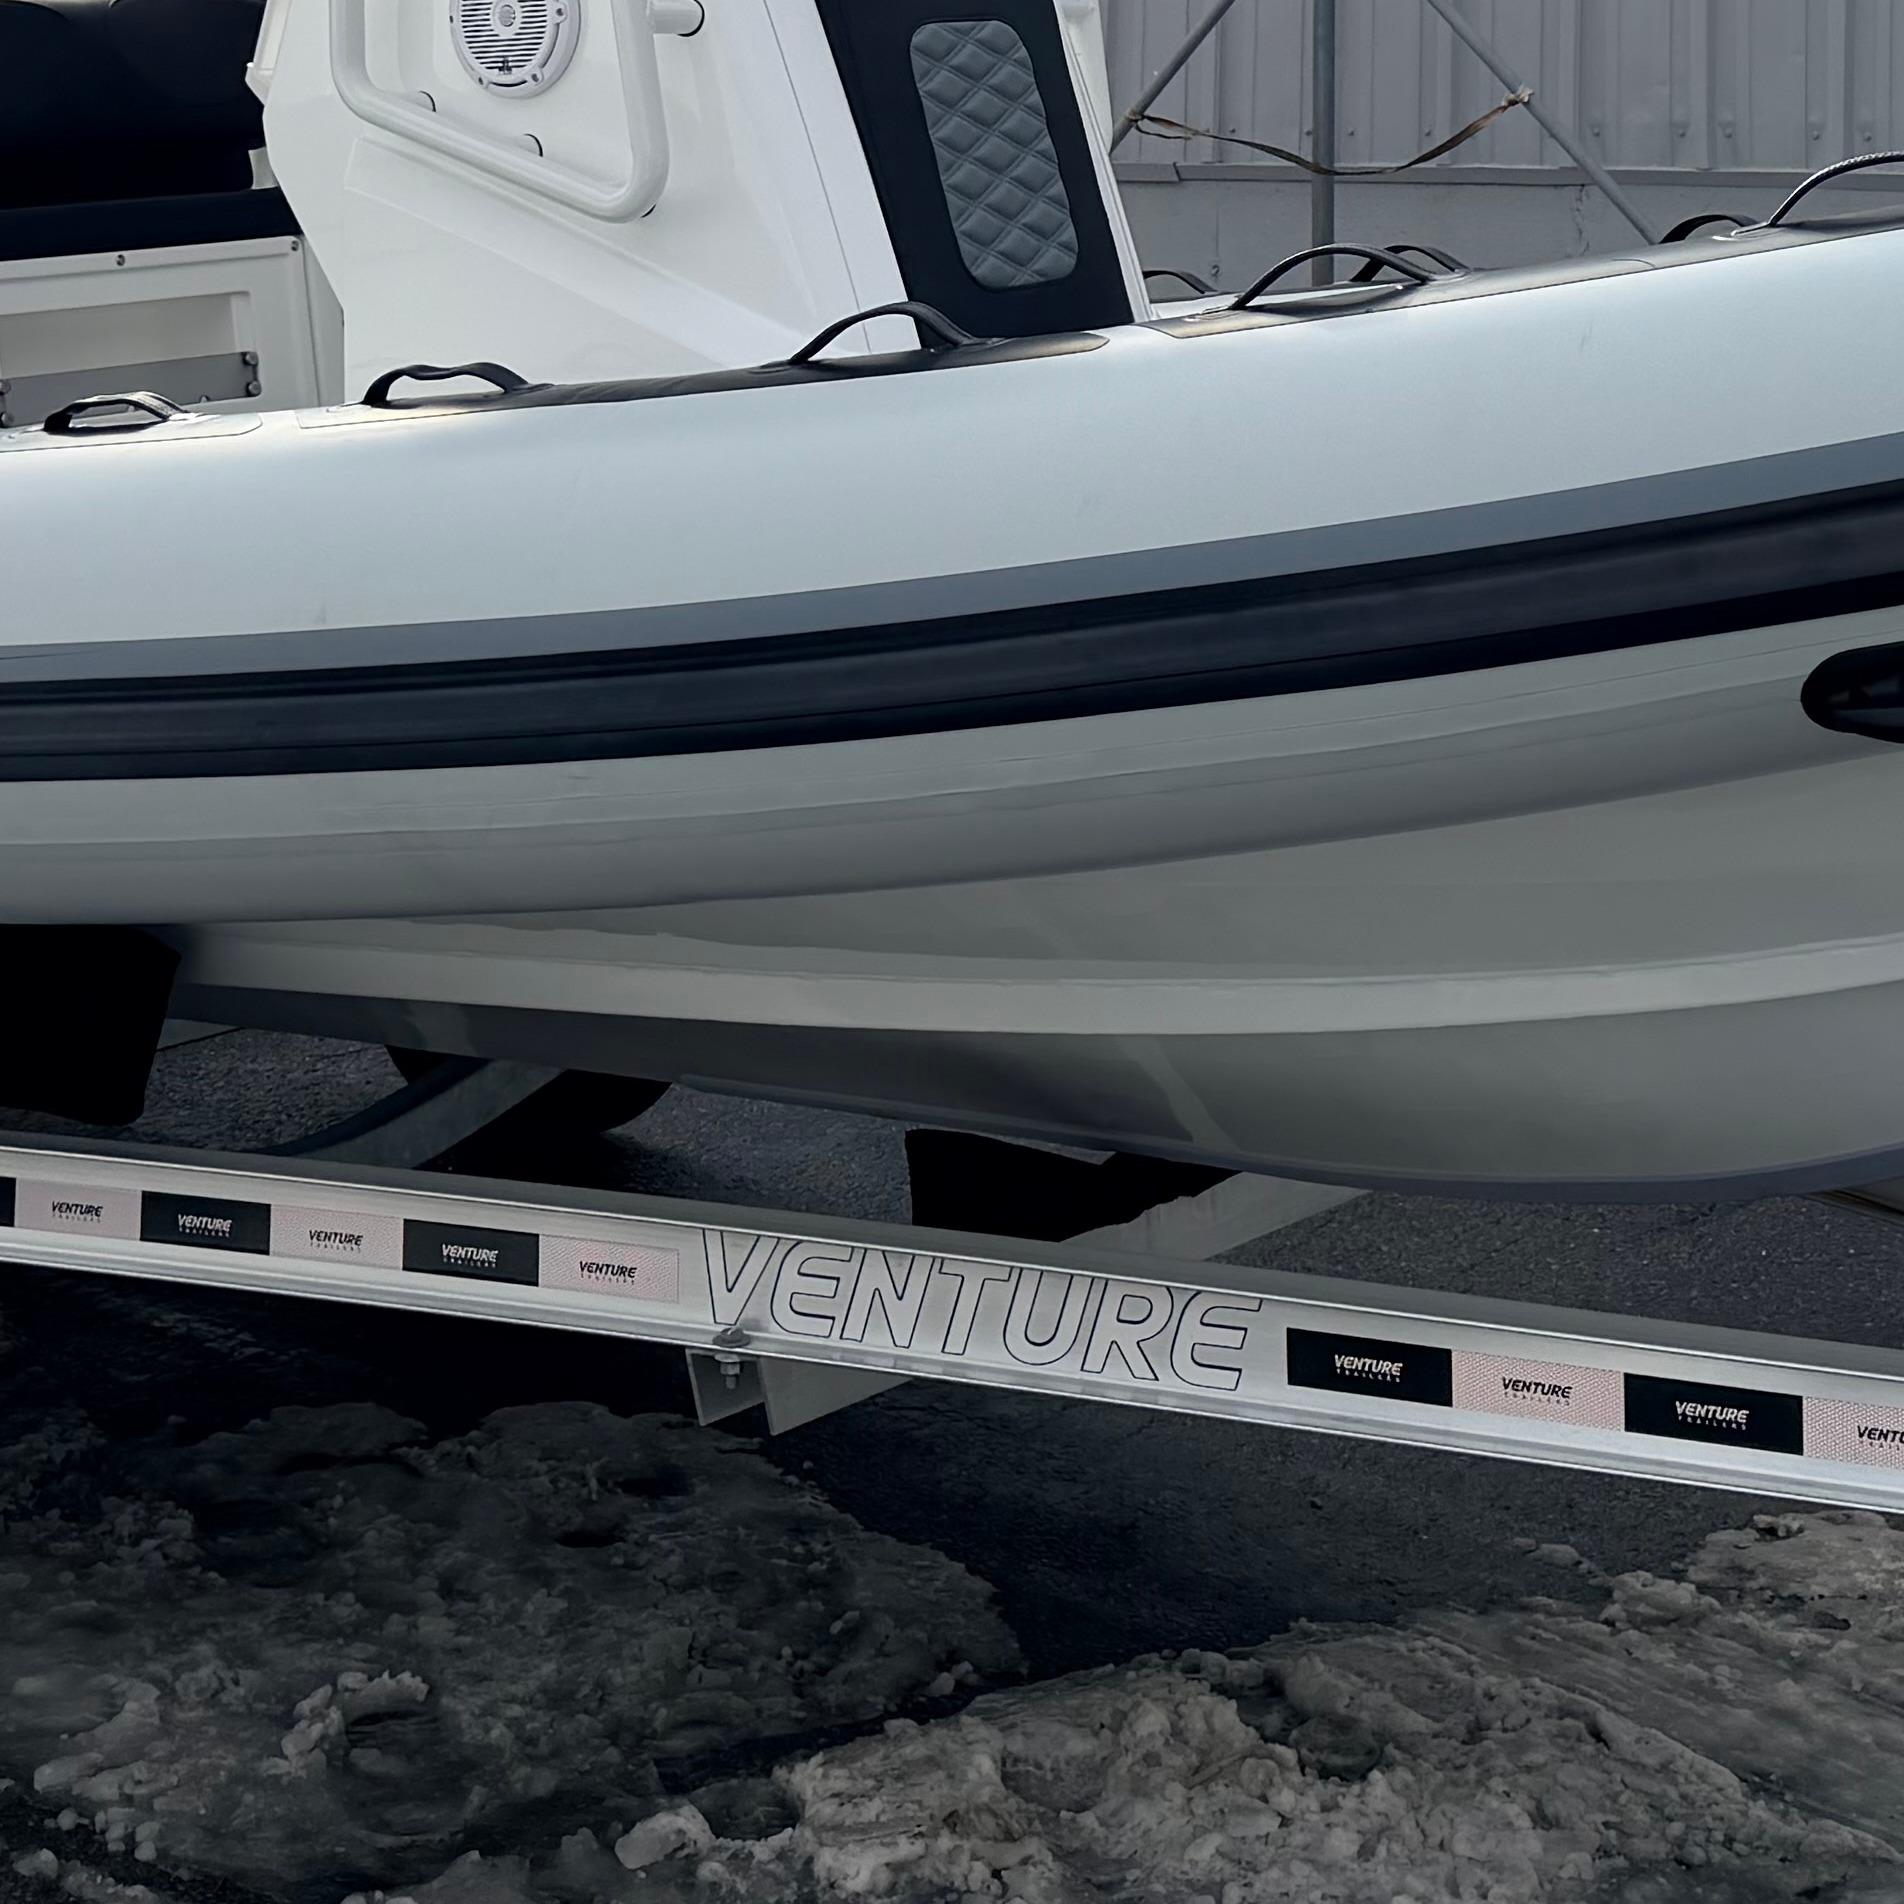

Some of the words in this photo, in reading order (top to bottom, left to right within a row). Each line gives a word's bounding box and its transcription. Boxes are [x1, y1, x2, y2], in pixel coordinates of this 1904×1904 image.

[51, 1200, 104, 1218] VENTURE
[177, 1214, 233, 1232] VENTURE
[309, 1229, 364, 1247] VENTURE
[442, 1243, 499, 1262] VENTURE
[579, 1261, 637, 1279] VENTURE
[703, 1228, 1262, 1391] VENTURE
[1334, 1354, 1403, 1376] VENTURE
[1502, 1376, 1573, 1399] VENTURE
[1675, 1401, 1750, 1422] VENTURE
